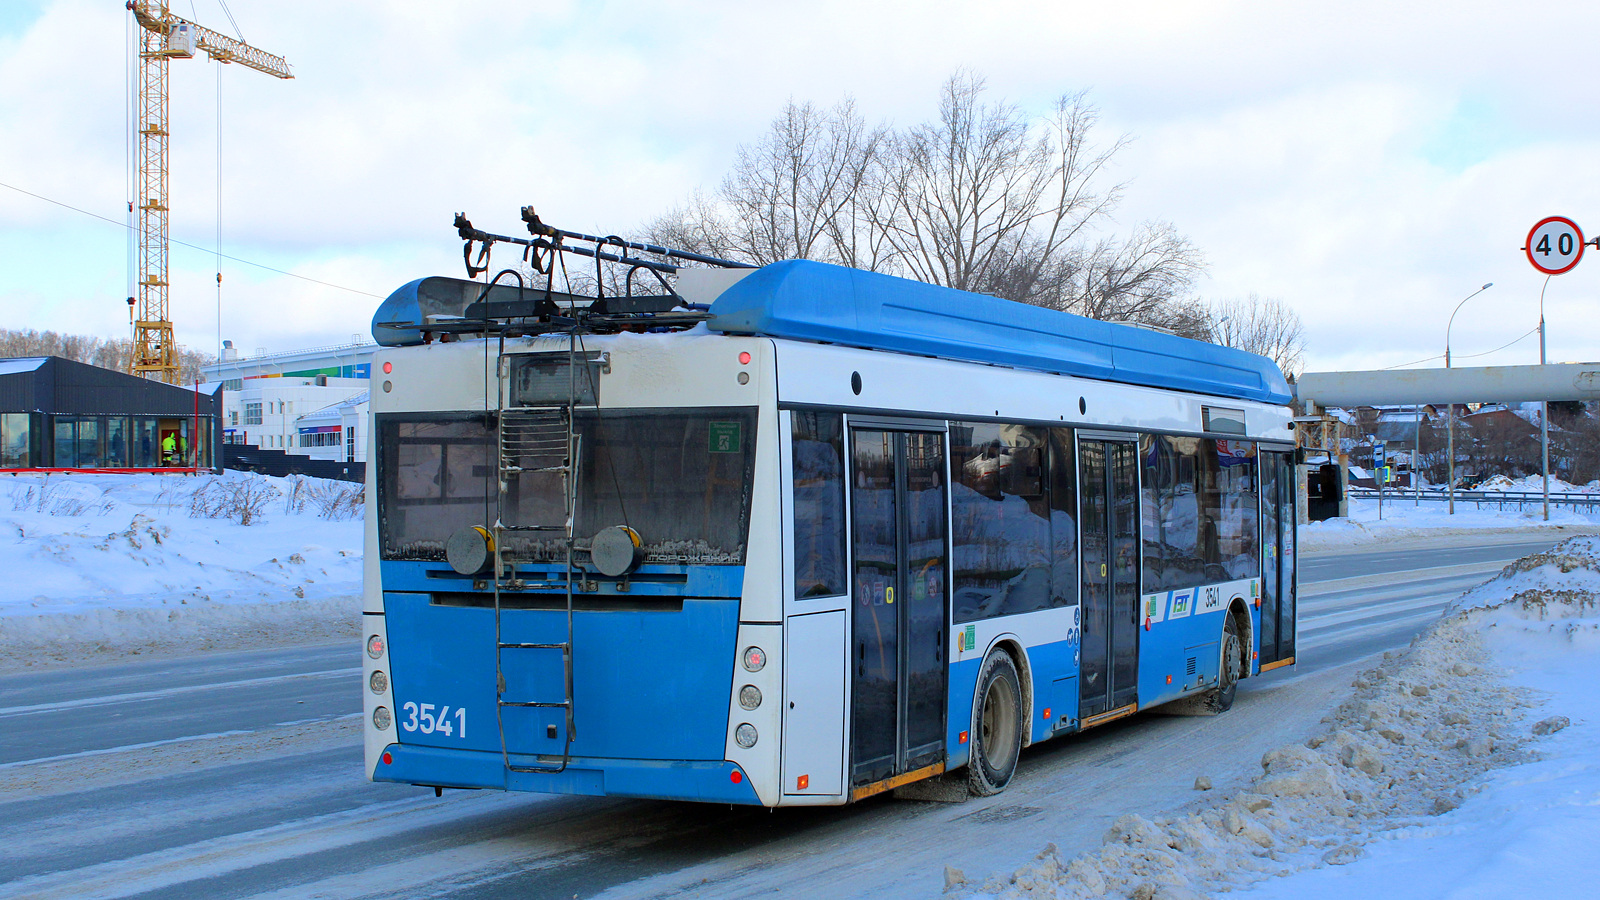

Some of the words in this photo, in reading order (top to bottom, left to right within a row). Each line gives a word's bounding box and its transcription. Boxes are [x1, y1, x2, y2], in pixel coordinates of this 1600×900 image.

[1536, 233, 1573, 256] 40
[649, 554, 741, 562] ГОРОЖАНИН
[1206, 587, 1219, 608] 3541
[402, 701, 466, 738] 3541
